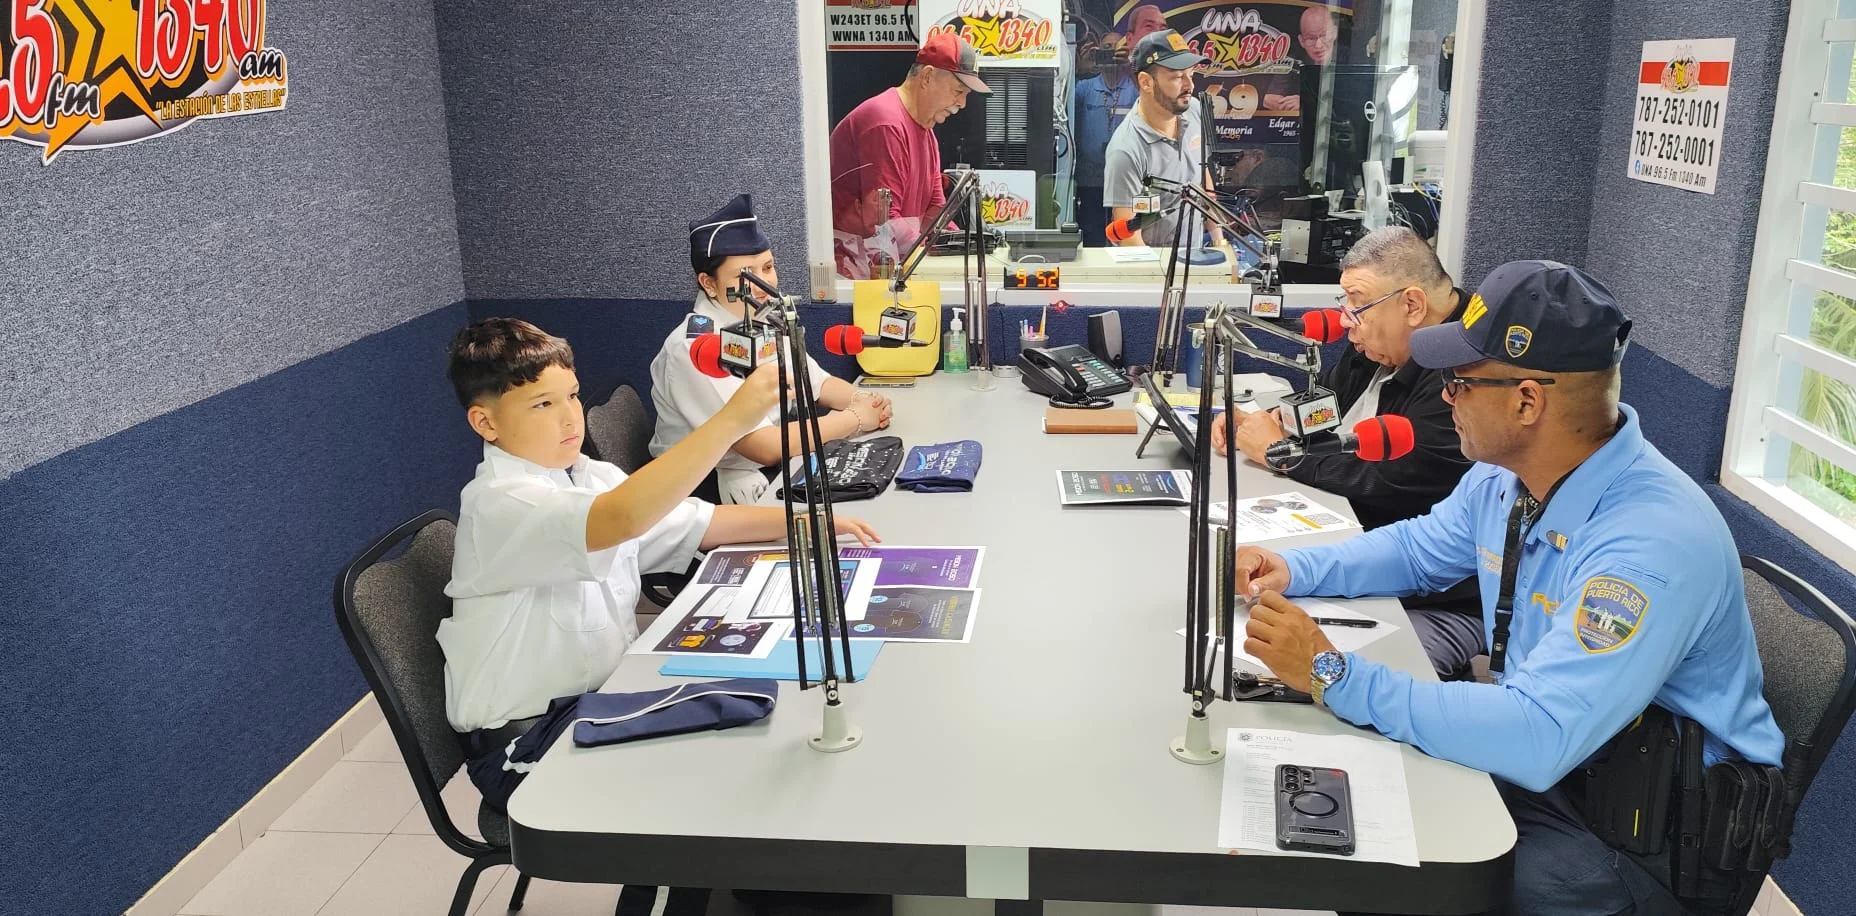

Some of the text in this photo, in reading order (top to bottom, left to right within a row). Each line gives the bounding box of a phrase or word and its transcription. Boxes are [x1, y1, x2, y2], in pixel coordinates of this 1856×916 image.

[830, 14, 871, 26] W243ET
[875, 14, 897, 26] 96.5
[1201, 7, 1261, 34] UNA
[832, 30, 866, 42] WWNA
[869, 30, 895, 42] 1340
[898, 30, 913, 42] AM
[998, 18, 1052, 51] 1340
[1238, 33, 1291, 65] 1340
[239, 51, 284, 80] am
[45, 72, 100, 128] fm
[215, 94, 226, 114] DE
[227, 93, 242, 112] LAS
[1638, 96, 1720, 129] 787-252-0101
[1215, 125, 1253, 136] Memoria
[1268, 117, 1296, 132] Edgar
[1634, 130, 1715, 167] 787-252-0001
[994, 198, 1030, 220] 1340
[1015, 268, 1059, 288] 9 52
[1585, 589, 1640, 617] PUERTO RICO
[1589, 581, 1645, 610] POLICIA DE
